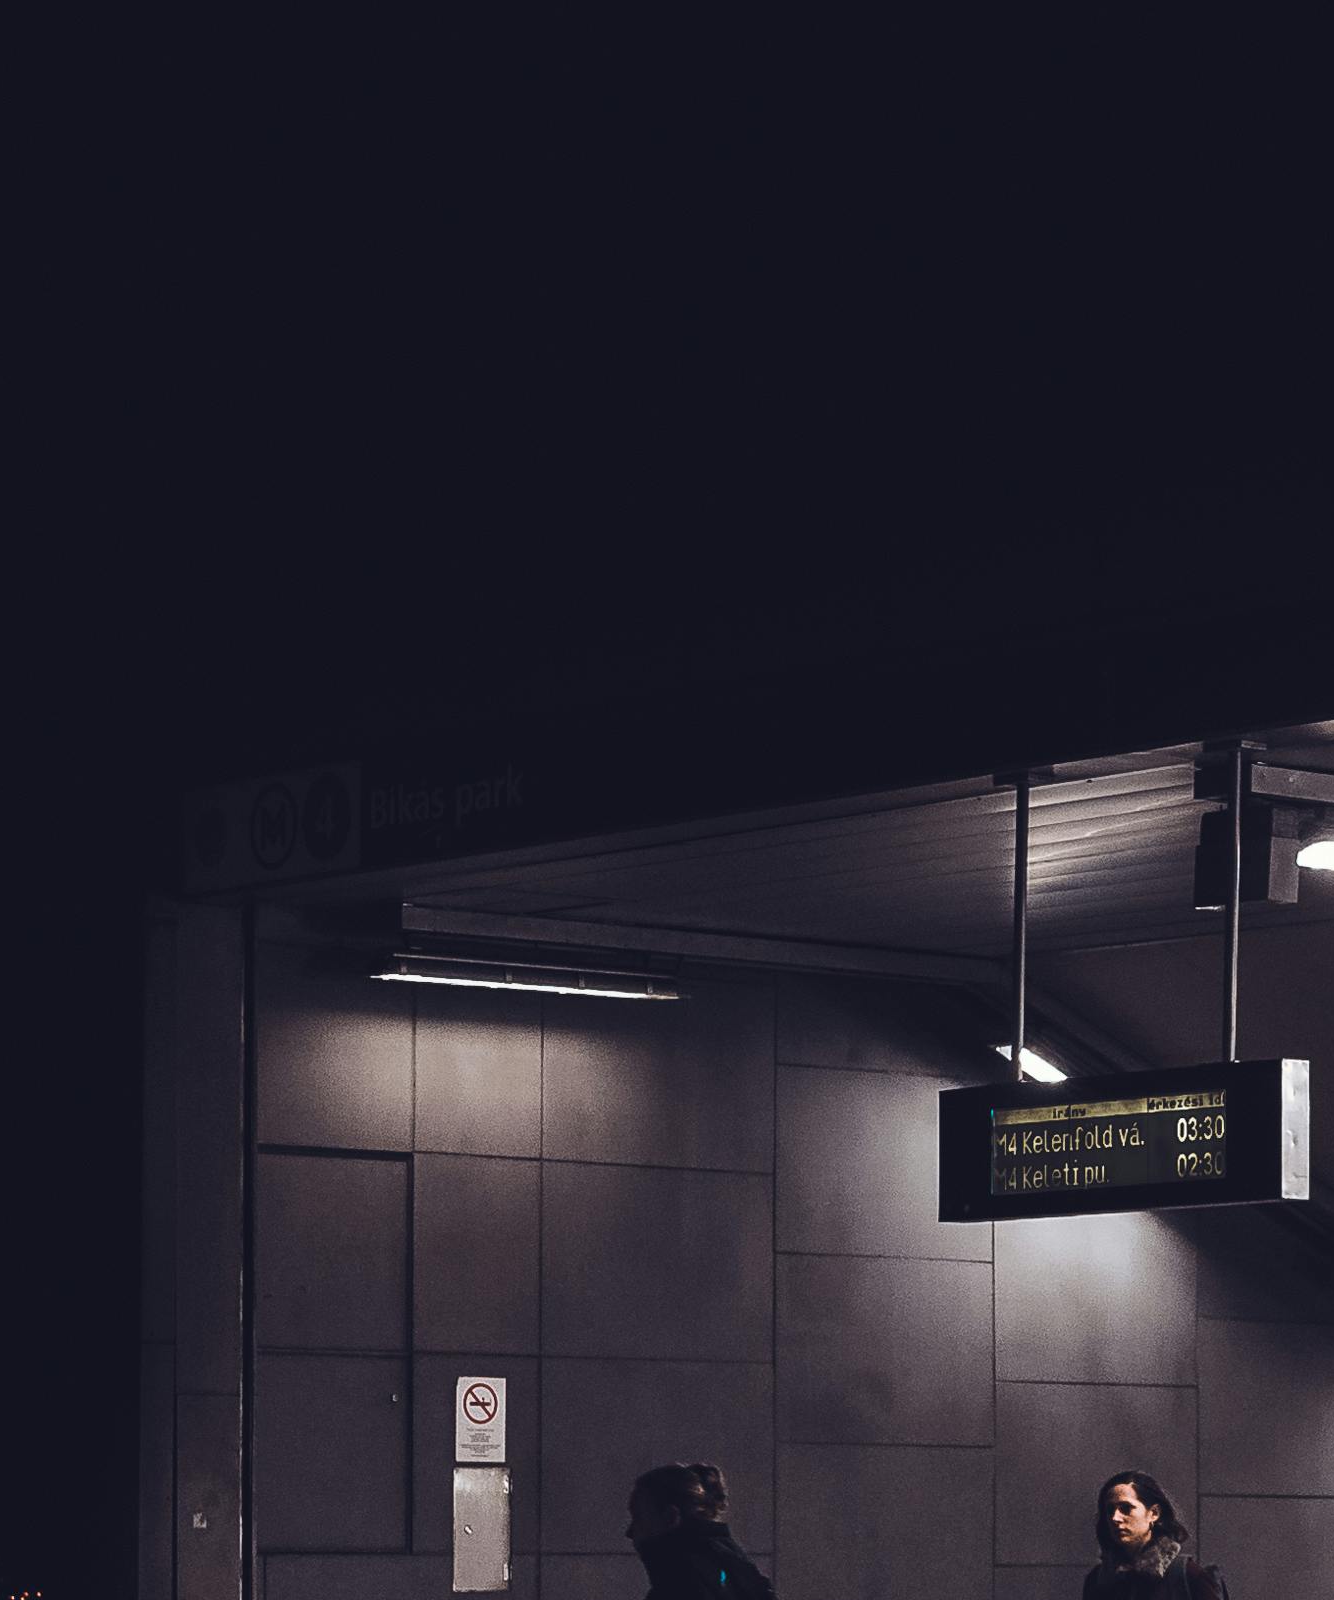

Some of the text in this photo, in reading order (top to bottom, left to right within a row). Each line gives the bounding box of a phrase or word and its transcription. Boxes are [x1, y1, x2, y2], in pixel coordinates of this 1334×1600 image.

[370, 776, 445, 829] Bikás
[454, 760, 524, 830] park
[1119, 1121, 1145, 1147] vá.
[1177, 1115, 1225, 1143] 03:30
[1022, 1159, 1079, 1190] Keleti
[1083, 1162, 1110, 1191] pu.
[1177, 1151, 1225, 1178] 02:30
